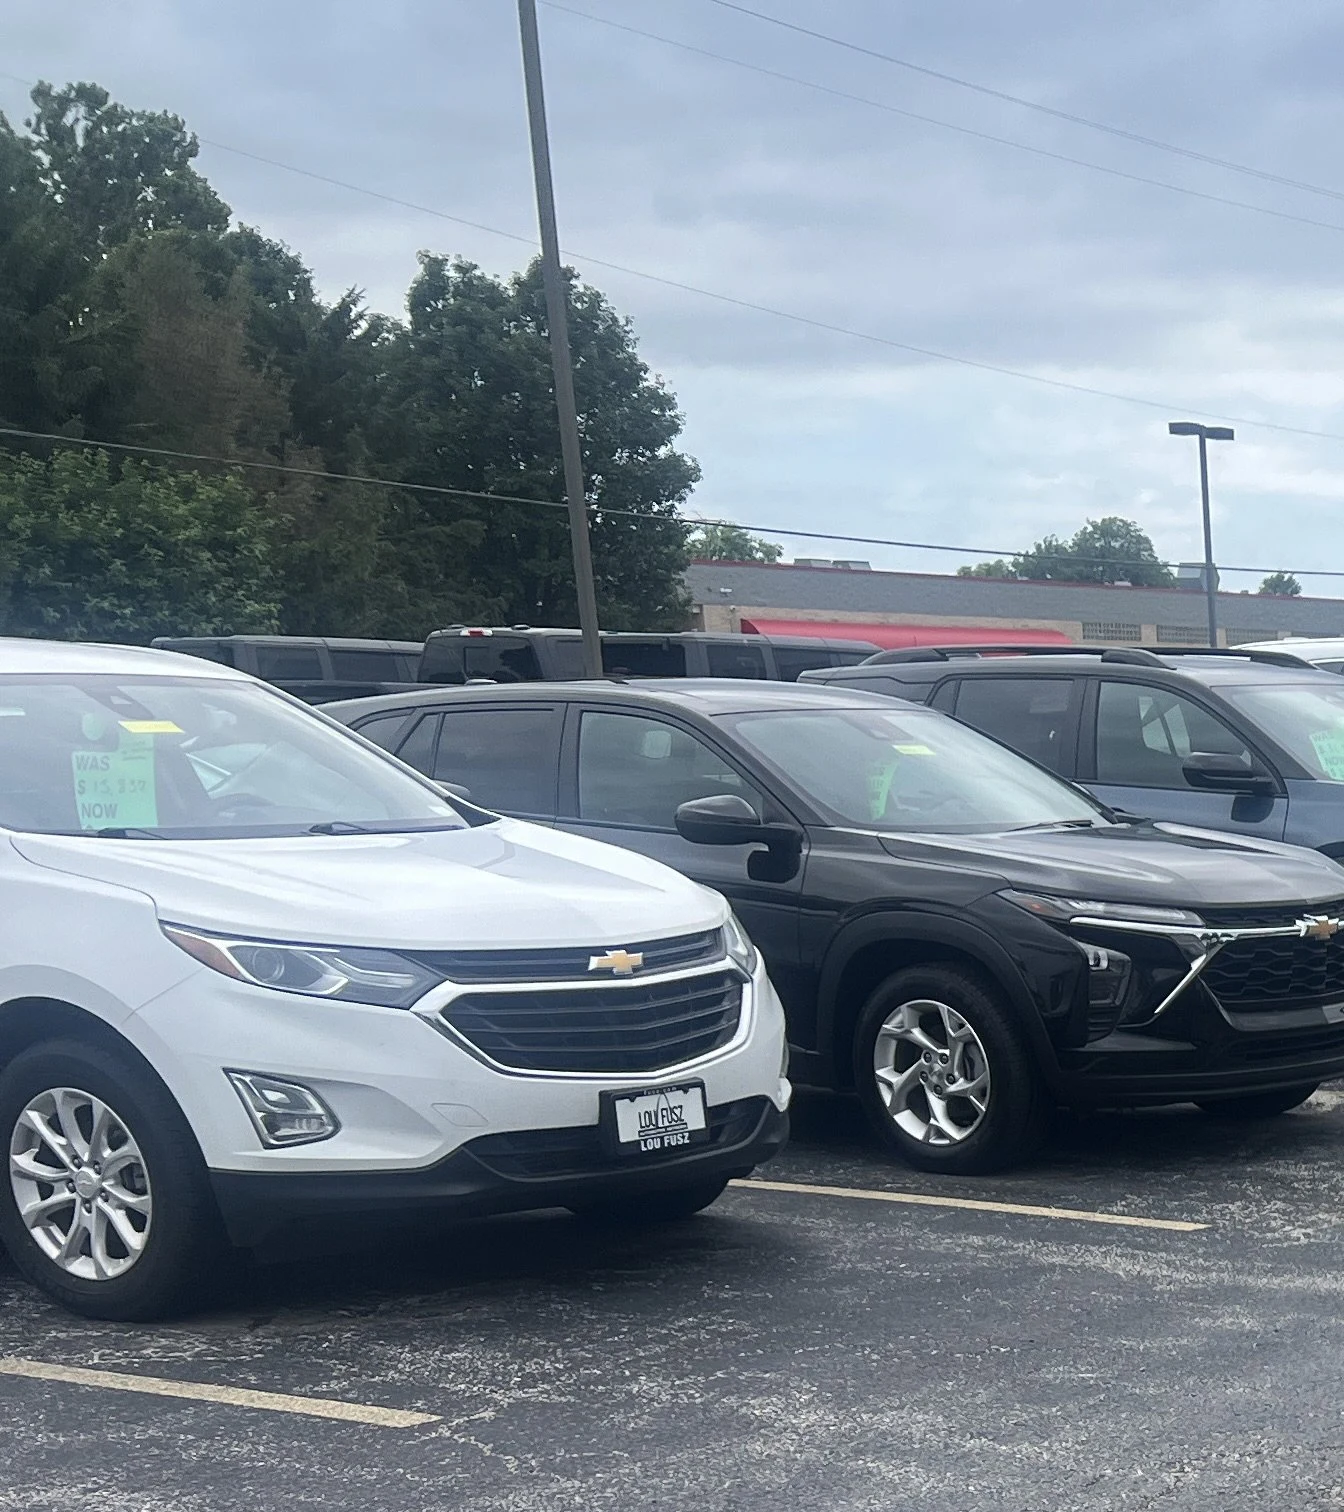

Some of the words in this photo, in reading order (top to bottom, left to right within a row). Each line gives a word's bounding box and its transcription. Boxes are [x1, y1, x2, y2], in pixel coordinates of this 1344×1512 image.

[75, 754, 110, 772] WAS
[81, 803, 118, 820] NOW
[640, 1137, 661, 1152] LOU
[664, 1132, 690, 1148] FUSZ
